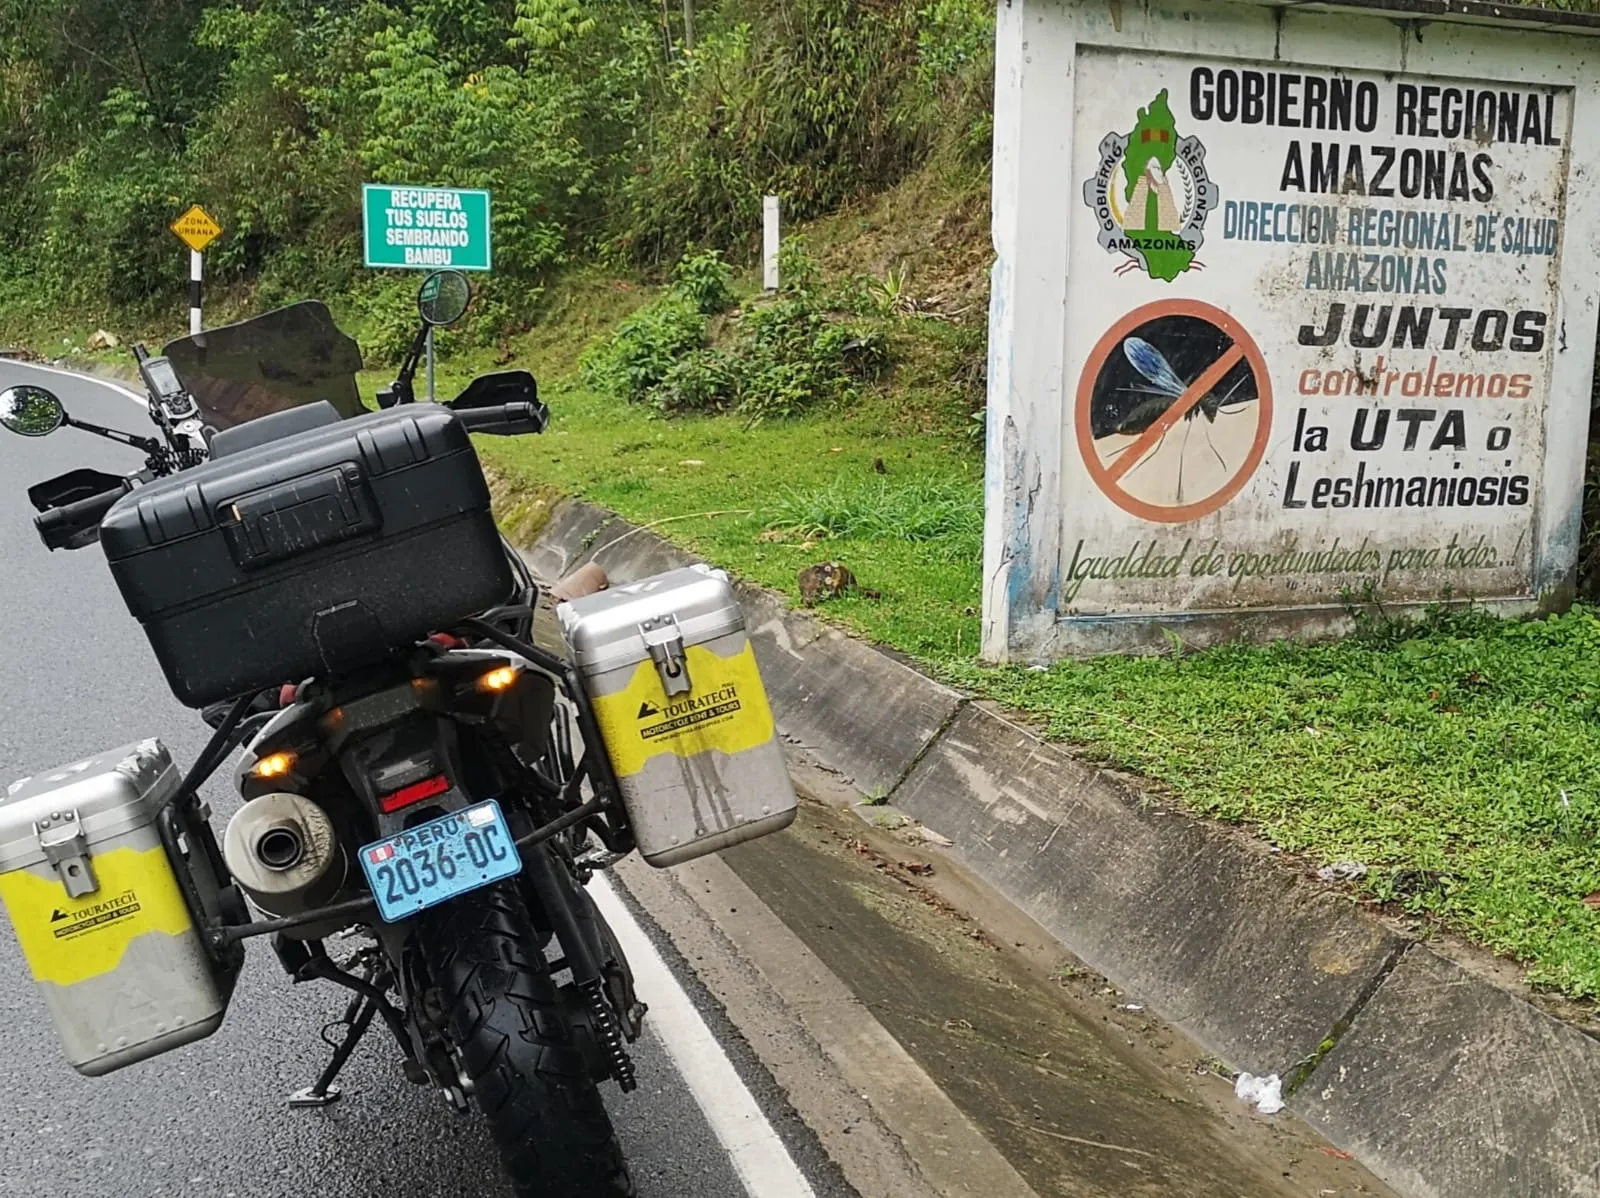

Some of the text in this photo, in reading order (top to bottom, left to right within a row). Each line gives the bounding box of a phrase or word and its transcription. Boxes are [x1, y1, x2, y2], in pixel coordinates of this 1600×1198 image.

[1190, 66, 1561, 147] GOBIERNO REGIONAL
[1096, 143, 1123, 231] GOBIERNO
[1180, 145, 1208, 231] REGIONAL
[1279, 139, 1494, 202] AMAZONAS
[184, 217, 208, 225] ZONA
[385, 208, 468, 229] TUS SUELOS
[391, 190, 462, 210] RECUPERA
[386, 228, 469, 247] SEMBRANDO
[1107, 238, 1197, 251] AMAZONAS
[1223, 200, 1559, 256] DIRECCION REGIONAL DE SALUD
[405, 247, 452, 265] BAMBU
[1305, 251, 1448, 295] AMAZONAS
[1297, 303, 1547, 353] JUNTOS
[1298, 355, 1532, 399] controlemos
[1292, 407, 1329, 452] la
[1350, 408, 1466, 452] UTA
[1282, 460, 1529, 509] Leshmaniosis
[1065, 538, 1192, 604] Igualdad
[1190, 539, 1225, 577] de
[1228, 537, 1381, 593] oportunidades
[1381, 547, 1441, 588] para
[662, 687, 737, 718] TOURATECH
[642, 717, 689, 737] MOTORCYCLE
[402, 818, 459, 851] PERU
[72, 892, 137, 920] TOURATECH
